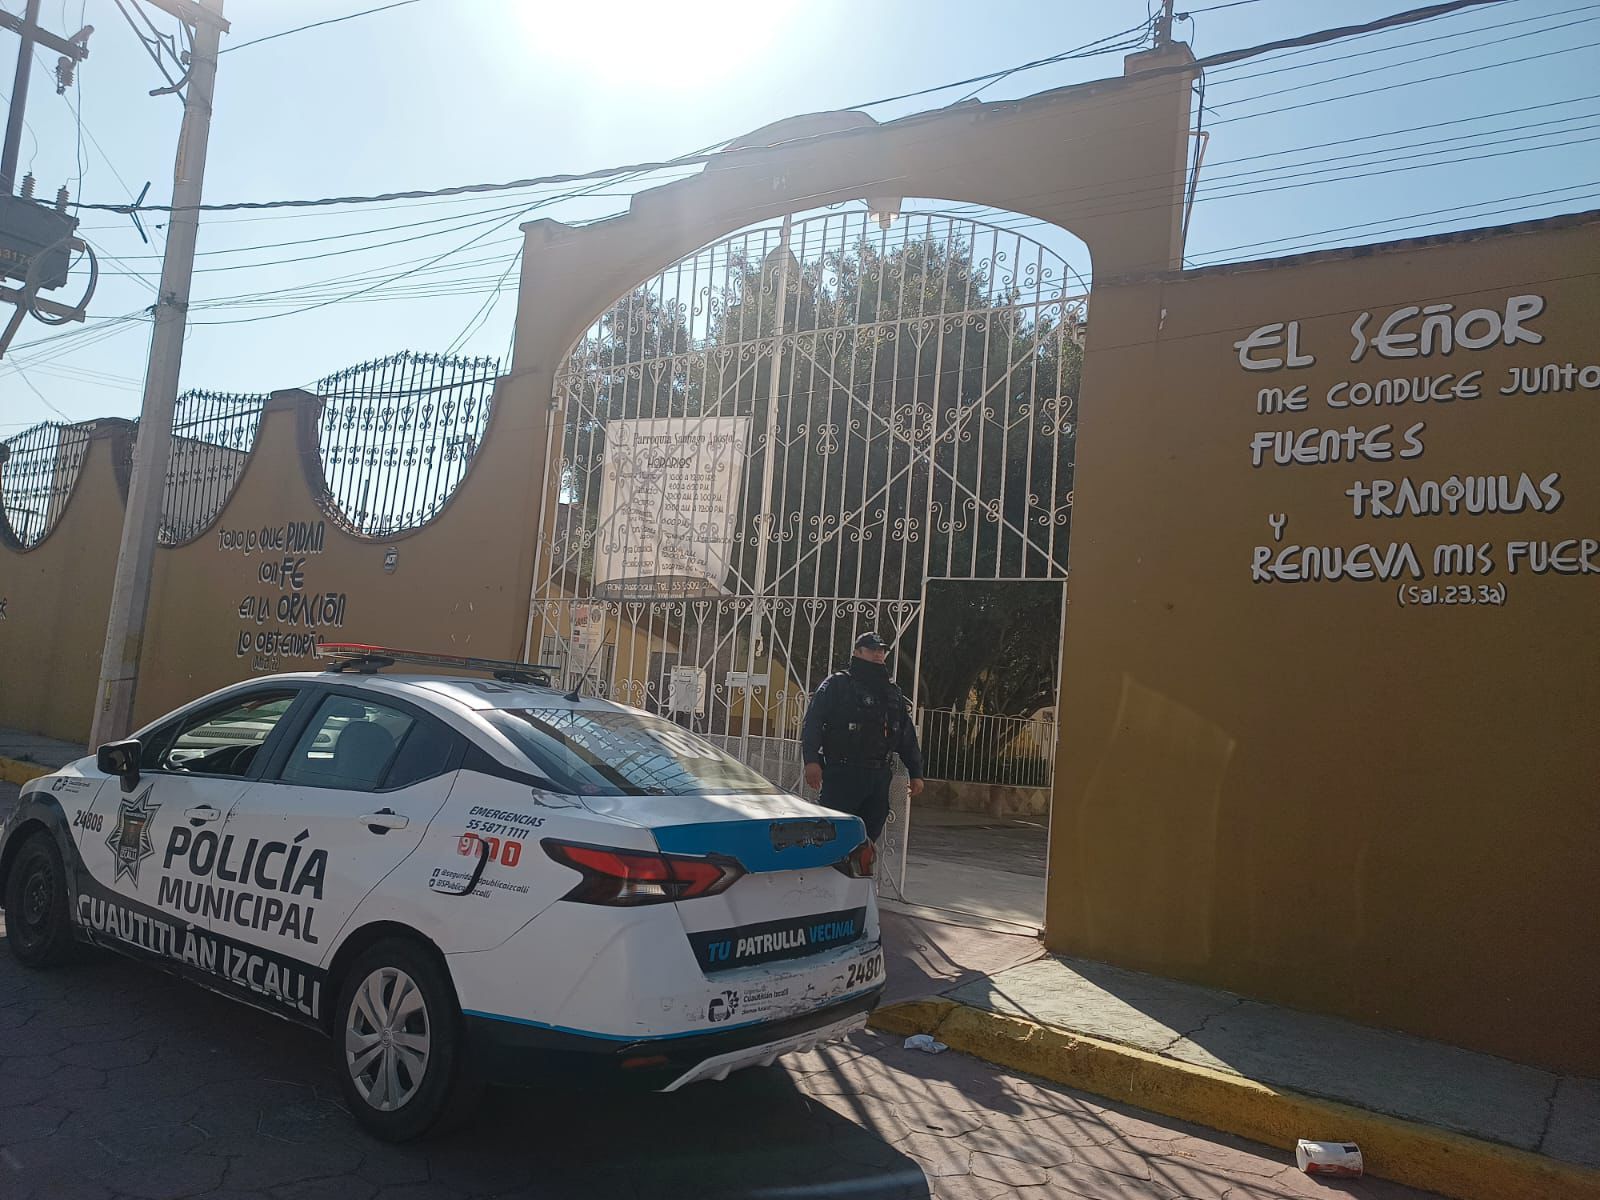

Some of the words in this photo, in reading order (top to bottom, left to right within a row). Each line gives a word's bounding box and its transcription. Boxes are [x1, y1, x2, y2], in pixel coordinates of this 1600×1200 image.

[1233, 320, 1315, 370] EL
[1350, 294, 1545, 362] SEÑOR
[1257, 385, 1308, 414] ME
[1326, 370, 1483, 408] CONDUCE
[1500, 363, 1600, 394] JUNTO
[647, 457, 692, 469] HORARIOS
[1250, 422, 1425, 466] FUENTES
[1346, 472, 1562, 516] TRANQUILAS
[218, 526, 243, 552] TODO
[243, 528, 257, 557] LO
[258, 525, 284, 553] QUE
[284, 520, 326, 554] PIDAN
[258, 560, 278, 585] CON
[280, 557, 305, 590] FE
[1251, 542, 1423, 582] RENUEVA
[1433, 542, 1494, 576] MIS
[238, 596, 256, 619] EN
[256, 597, 270, 625] LA
[276, 592, 347, 628] ORACIÓN
[236, 629, 251, 658] LO
[73, 809, 104, 833] 24808
[466, 819, 480, 830] 55
[469, 806, 546, 828] EMERGENCIAS
[162, 825, 329, 900] POLICÍA
[157, 875, 319, 945] MUNICIPAL
[77, 894, 217, 976] CUAUTITLÁN
[223, 944, 321, 1020] IZCALLI
[708, 940, 731, 962] TU
[736, 928, 806, 958] PATRULLA
[809, 919, 857, 943] VECINAL
